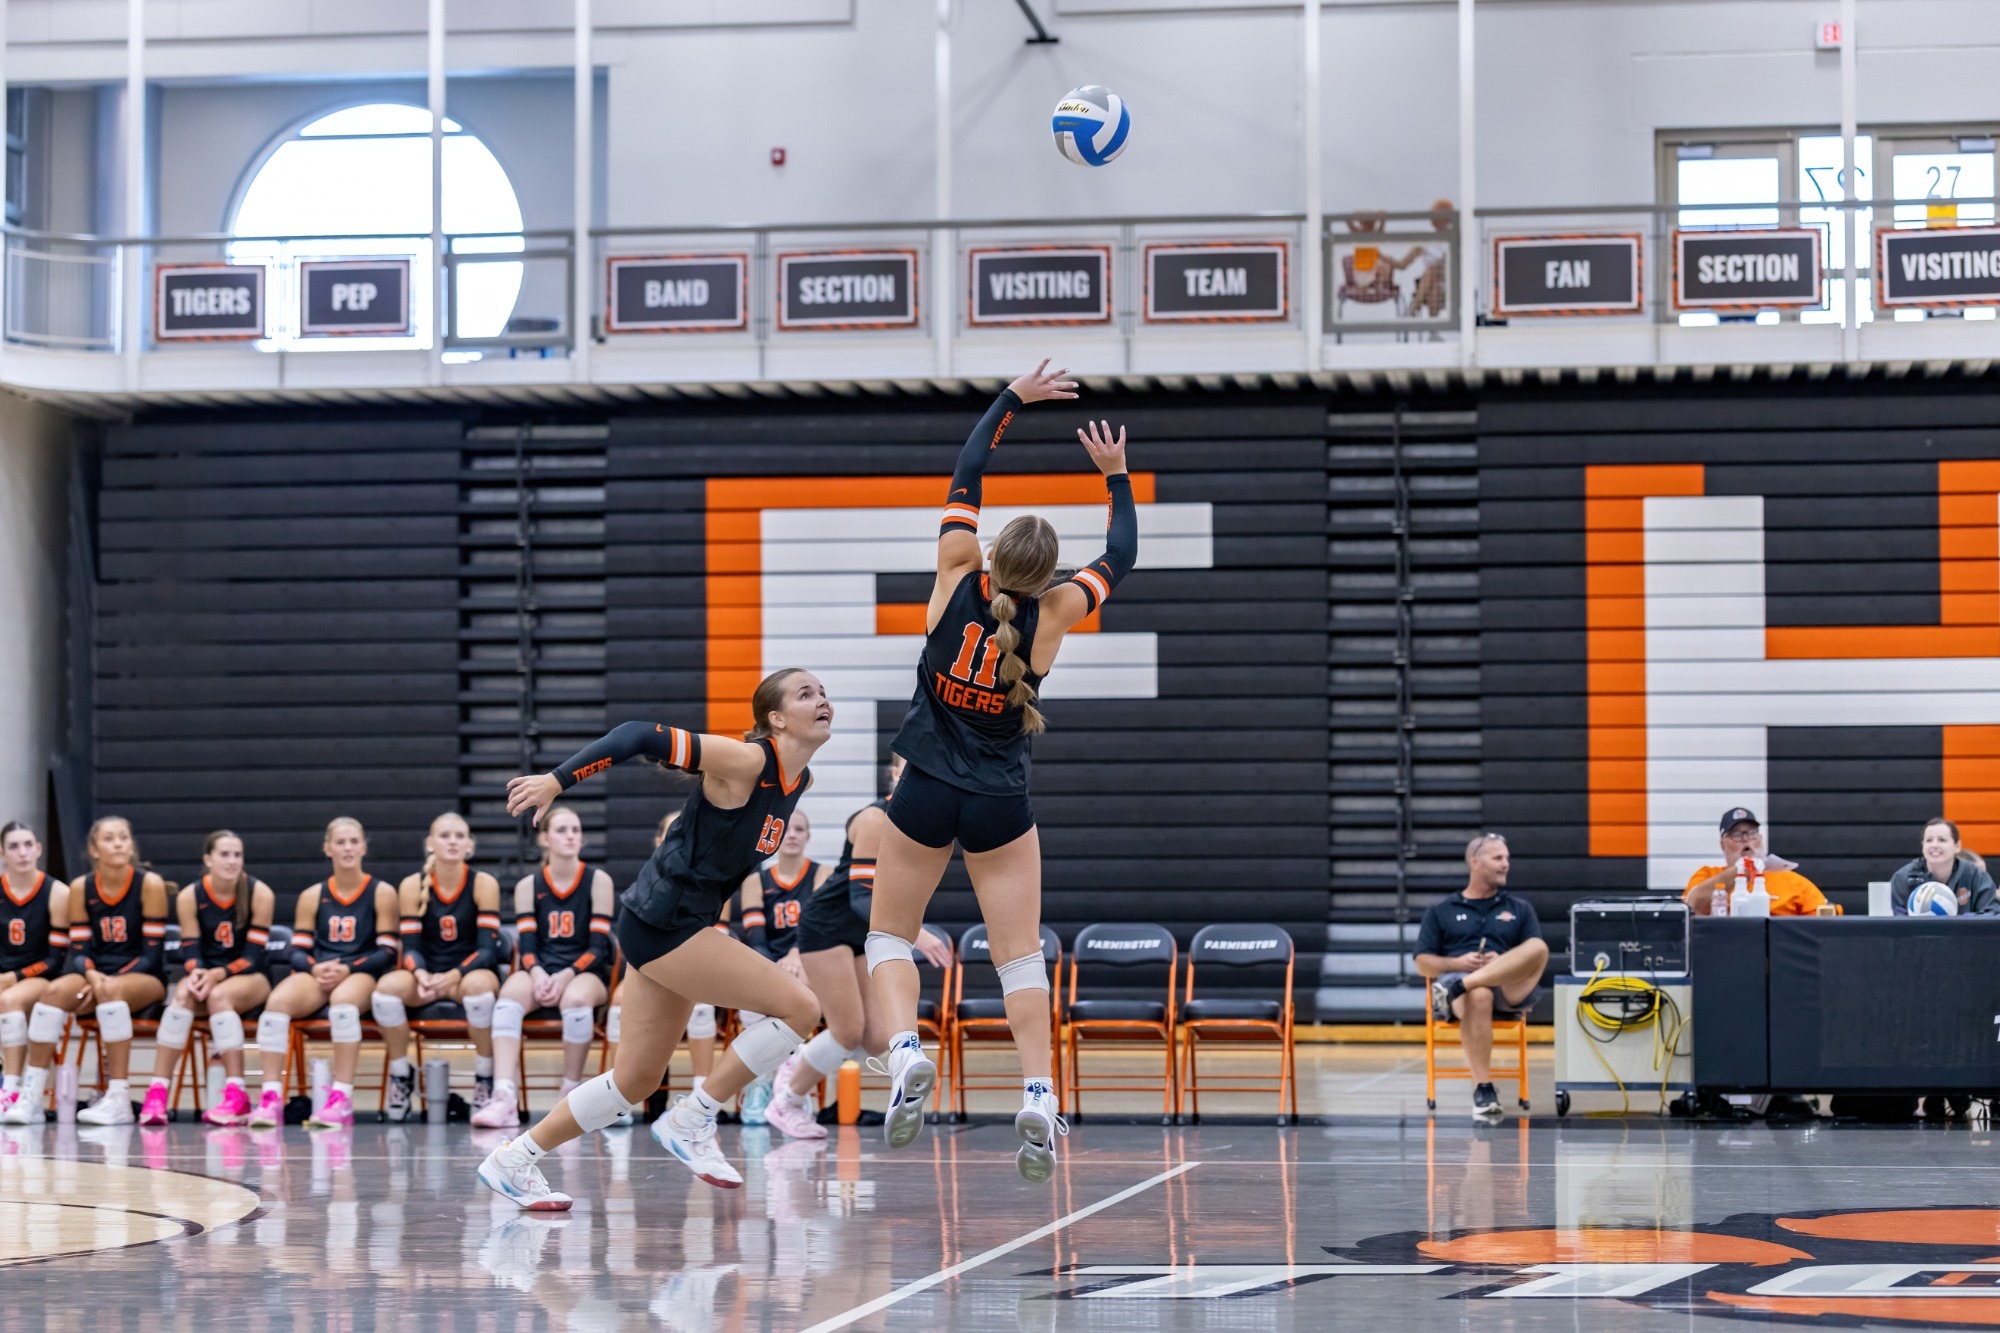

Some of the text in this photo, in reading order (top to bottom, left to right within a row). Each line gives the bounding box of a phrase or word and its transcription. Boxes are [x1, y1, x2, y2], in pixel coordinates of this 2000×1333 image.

[1926, 166, 1962, 200] 27
[1544, 260, 1591, 289] FAN
[1698, 252, 1799, 284] SECTION
[1901, 248, 2000, 282] VISITING
[645, 279, 709, 308] BAND
[799, 273, 896, 304] SECTION
[989, 268, 1090, 300] VISITING
[1184, 267, 1248, 297] TEAM
[171, 287, 251, 317] TIGERS
[331, 283, 378, 312] PEP
[949, 621, 1001, 689] 11
[935, 671, 1006, 715] TIGERS
[755, 814, 784, 855] 23
[328, 915, 357, 942] 13
[439, 915, 458, 941] 9
[548, 911, 575, 938] 18
[773, 900, 800, 929] 19
[8, 919, 26, 945] 6
[100, 916, 128, 943] 12
[214, 921, 234, 948] 4
[1087, 939, 1161, 950] FARMINGTON
[1204, 939, 1278, 950] FARMINGTON
